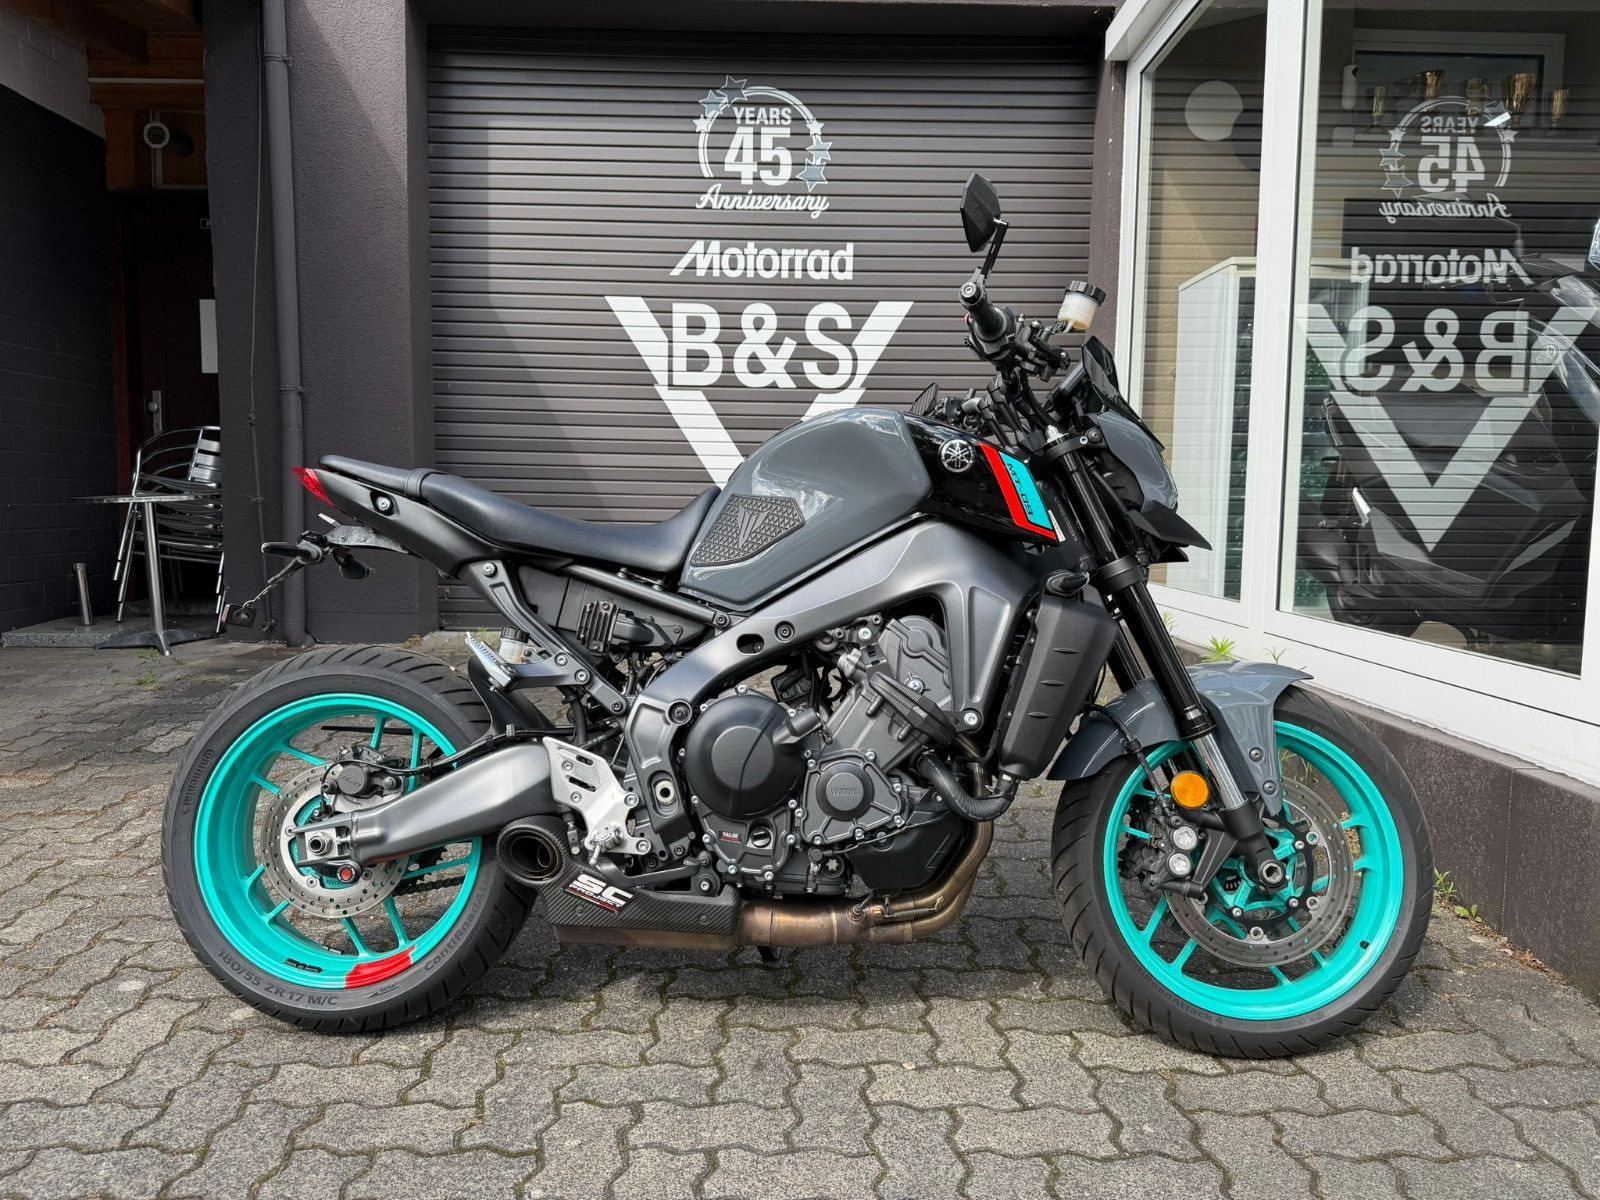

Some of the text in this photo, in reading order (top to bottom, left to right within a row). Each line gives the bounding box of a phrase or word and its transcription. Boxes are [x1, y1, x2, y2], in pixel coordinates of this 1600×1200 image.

[733, 107, 792, 126] YEARS
[724, 126, 792, 186] 45
[696, 184, 829, 219] Anniversary
[669, 240, 854, 281] Motorrad
[672, 302, 855, 389] B&S
[218, 949, 262, 986] 180/55
[307, 995, 339, 1006] M/C
